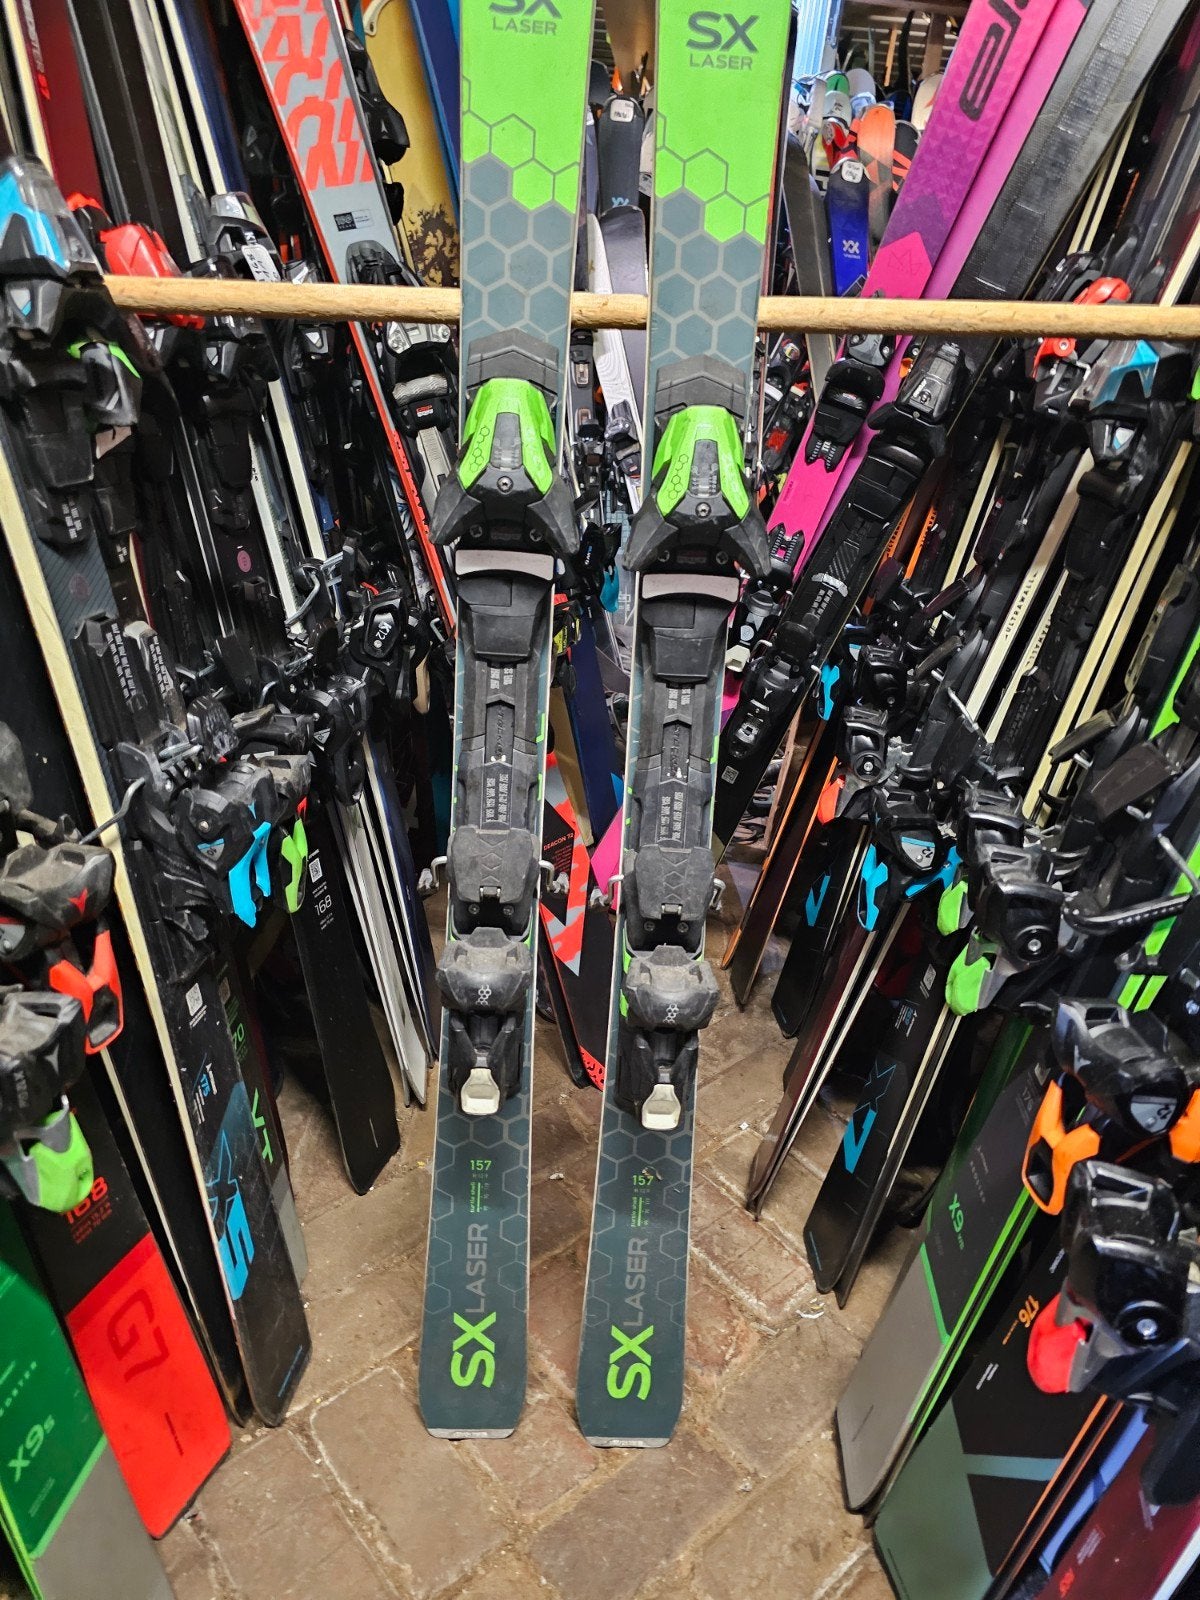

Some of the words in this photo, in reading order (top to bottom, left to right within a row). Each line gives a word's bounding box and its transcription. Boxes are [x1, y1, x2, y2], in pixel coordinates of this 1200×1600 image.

[492, 17, 557, 35] LASER
[685, 10, 760, 53] SX
[689, 53, 753, 70] LASER
[1005, 577, 1035, 632] ULTRAWALL
[543, 834, 567, 851] DEACON
[314, 894, 333, 917] 168
[469, 1159, 493, 1171] 157
[632, 1174, 655, 1187] 157
[465, 1223, 489, 1313] LASER
[623, 1237, 649, 1327] LASER
[1018, 1295, 1040, 1328] 176
[450, 1311, 497, 1388] SX
[606, 1324, 654, 1400] SX
